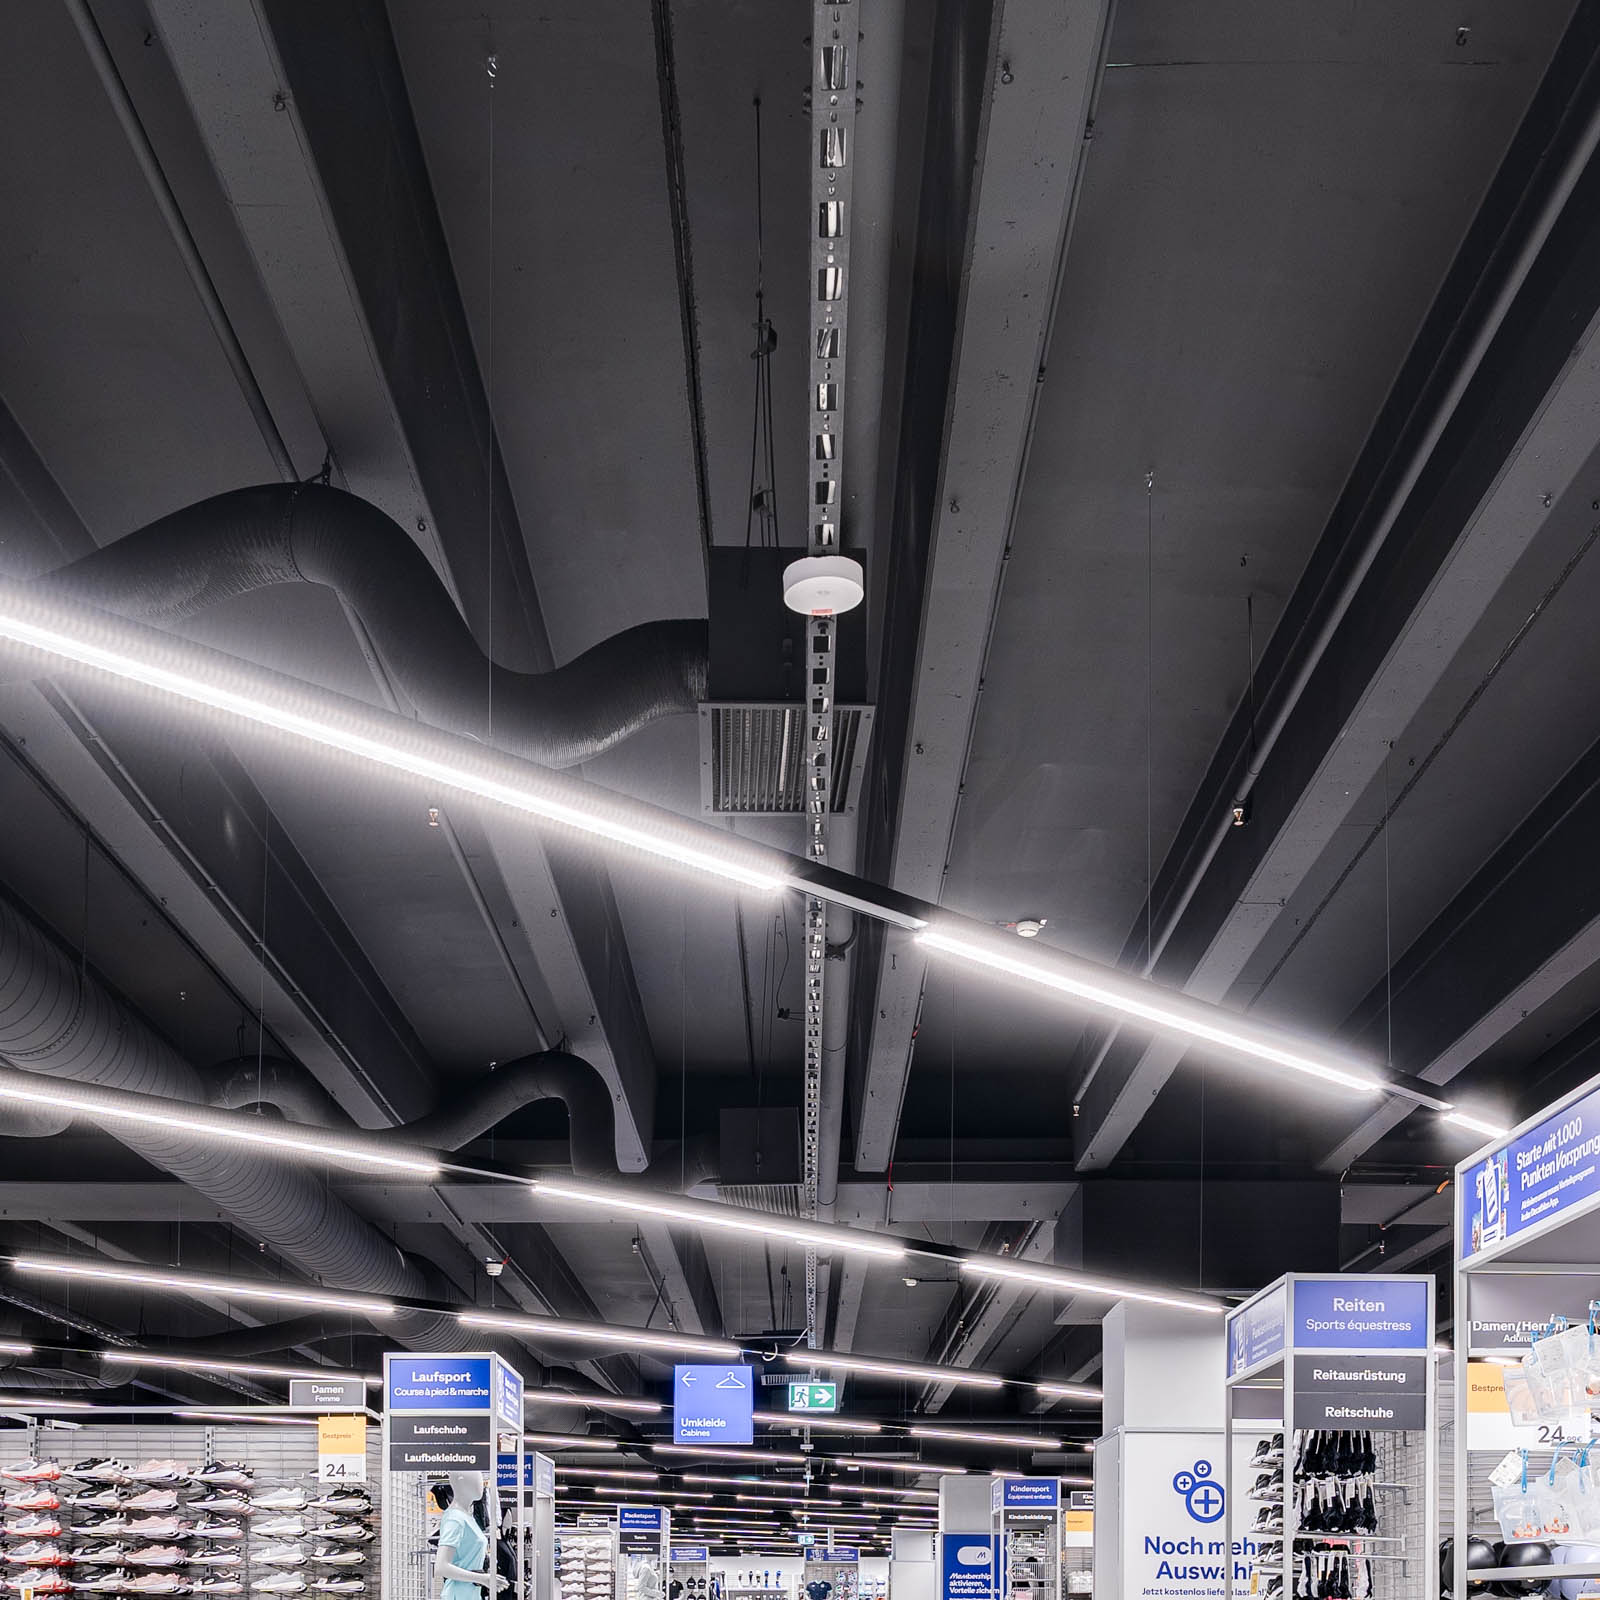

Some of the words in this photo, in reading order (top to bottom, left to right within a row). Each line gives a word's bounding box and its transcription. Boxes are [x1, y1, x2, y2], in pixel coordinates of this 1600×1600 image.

[1516, 1145, 1542, 1171] Starte
[1542, 1133, 1557, 1157] mit
[1521, 1160, 1556, 1191] Punkten
[1333, 1298, 1385, 1312] Reiten
[1306, 1318, 1346, 1332] Sports
[1347, 1319, 1412, 1332] équestress
[412, 1371, 472, 1384] Laufsport
[1313, 1369, 1407, 1384] Reitausrüstung
[311, 1385, 345, 1395] Damen
[394, 1388, 424, 1396] Course
[432, 1387, 449, 1398] pied
[450, 1388, 457, 1396] &
[458, 1387, 489, 1396] marche
[1325, 1407, 1394, 1418] Reitschuhe
[680, 1417, 727, 1427] Umkleide
[414, 1425, 467, 1435] Laufschuhe
[680, 1429, 710, 1437] Cabines
[404, 1453, 477, 1464] Laufbekleidung
[1010, 1485, 1050, 1493] Kindersport
[1144, 1536, 1203, 1555] Noch
[1142, 1588, 1162, 1596] Jetzt
[1164, 1588, 1206, 1596] kostenlos
